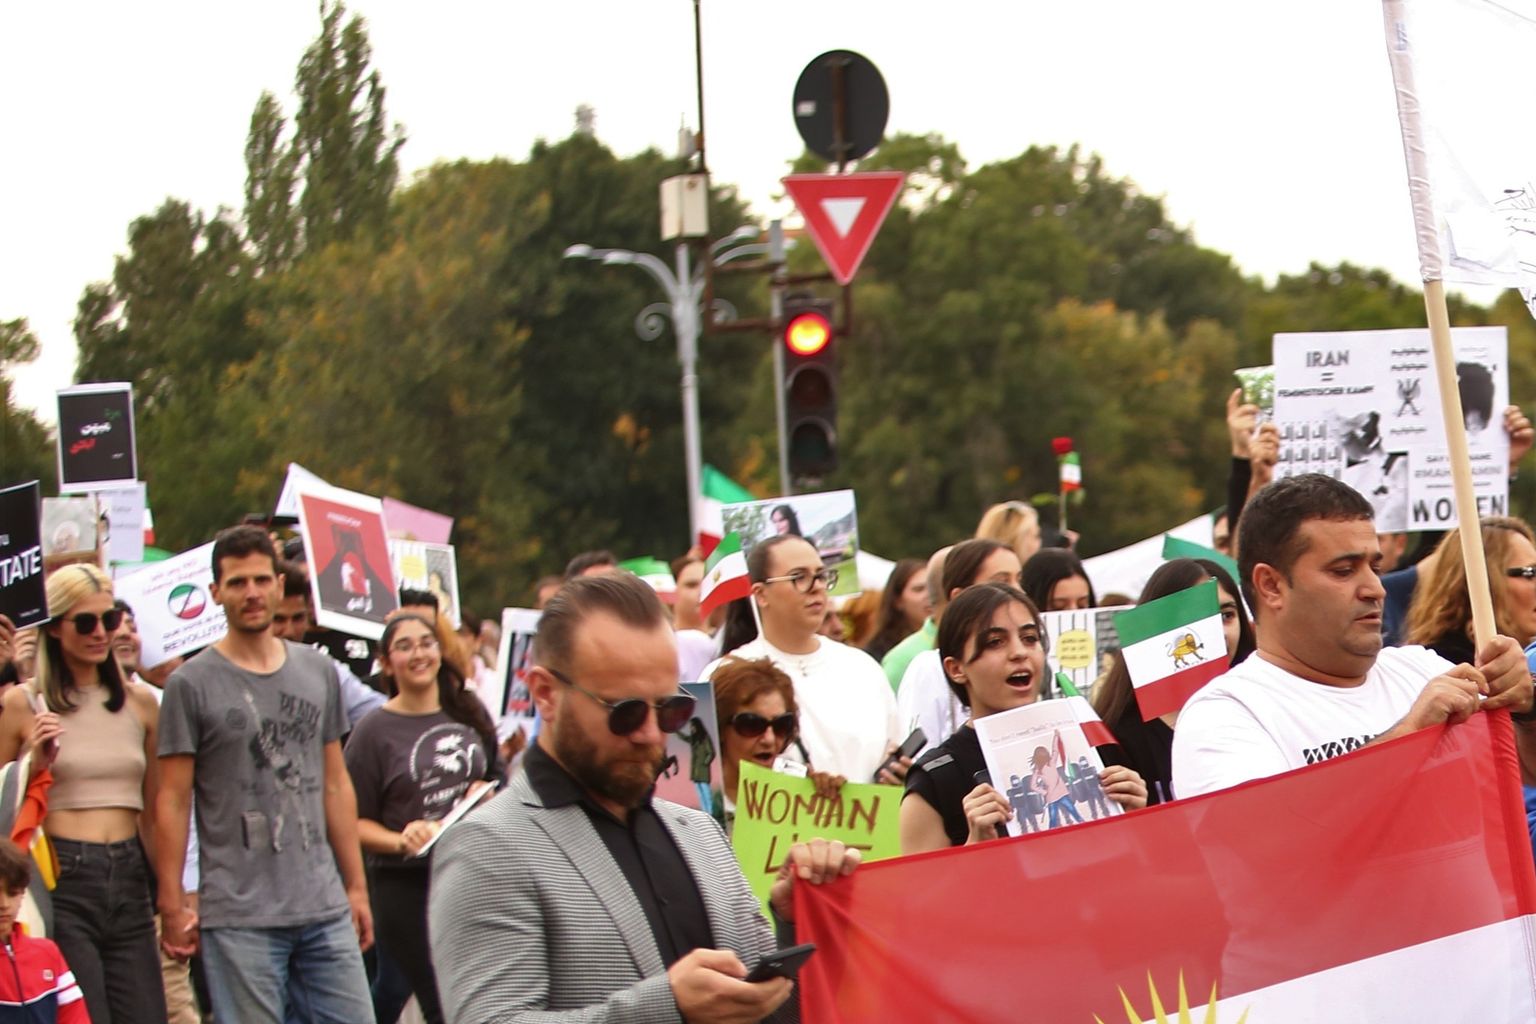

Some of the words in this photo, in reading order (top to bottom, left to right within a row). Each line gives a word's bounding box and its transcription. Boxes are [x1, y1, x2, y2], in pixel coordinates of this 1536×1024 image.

[1306, 350, 1349, 368] IRAN
[1413, 494, 1504, 522] WOEN
[0, 545, 41, 588] TATE
[743, 778, 880, 834] WOMAN
